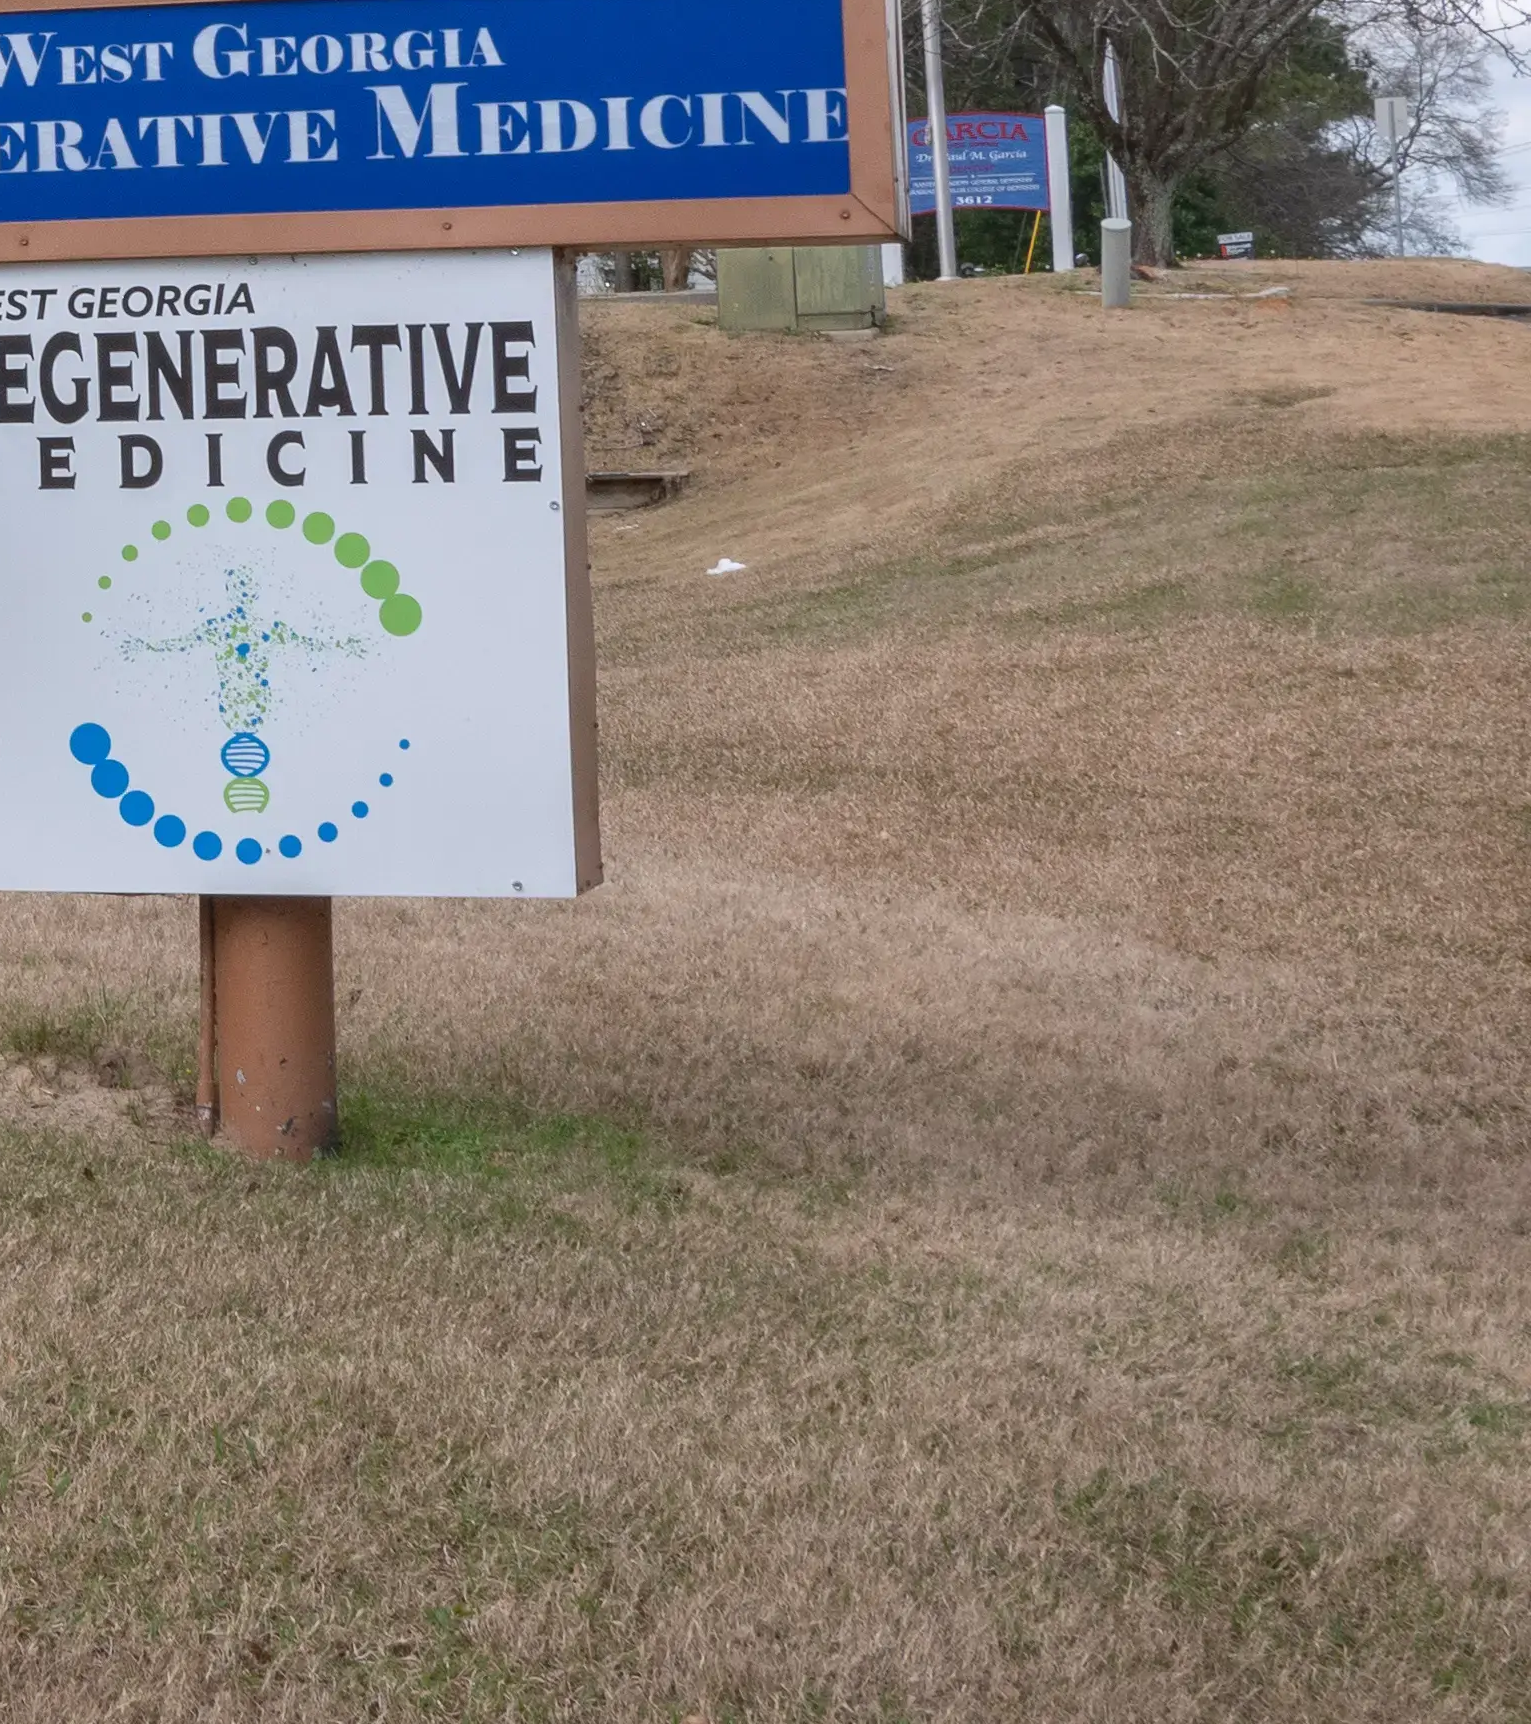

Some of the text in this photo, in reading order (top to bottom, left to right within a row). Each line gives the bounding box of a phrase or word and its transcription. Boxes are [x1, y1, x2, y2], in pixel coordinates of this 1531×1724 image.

[192, 23, 507, 80] GEORGIA
[366, 82, 850, 161] MEDICINE
[955, 196, 993, 205] 3612
[67, 282, 256, 320] GEORGIA
